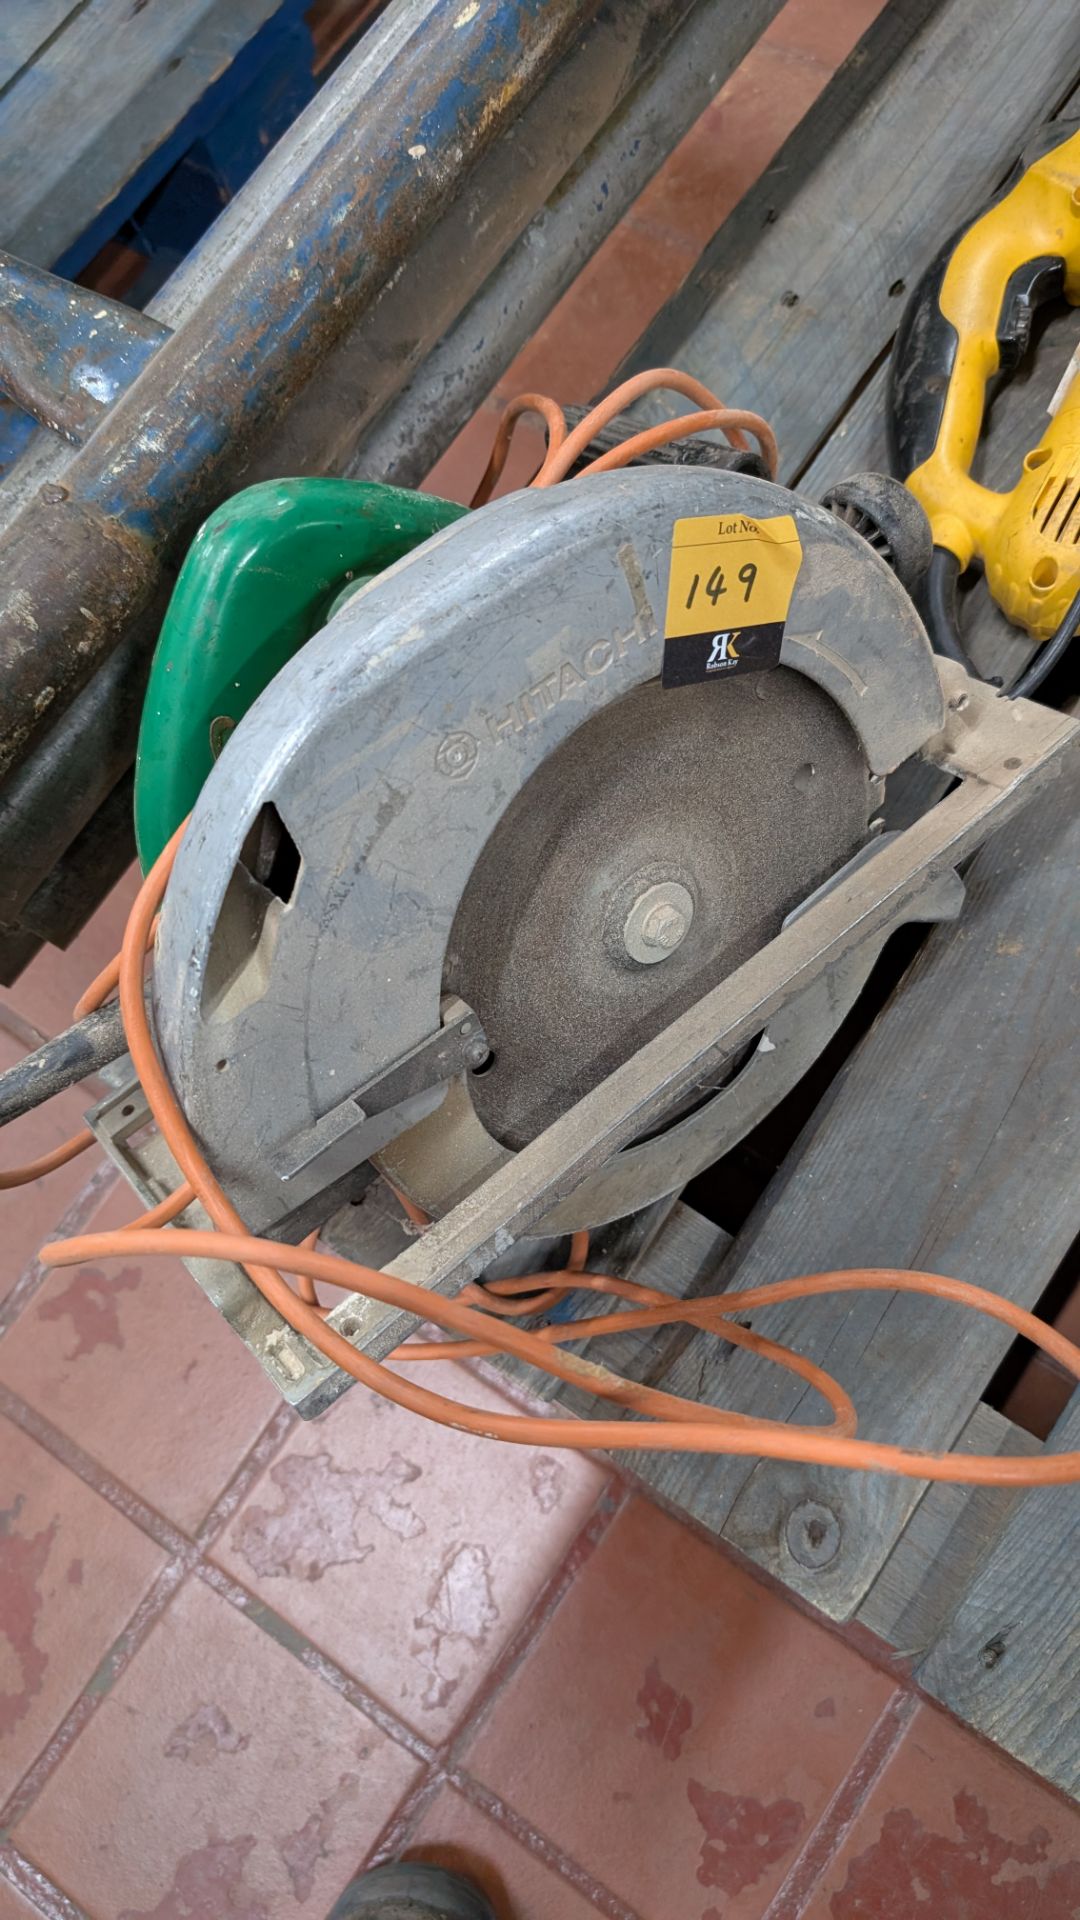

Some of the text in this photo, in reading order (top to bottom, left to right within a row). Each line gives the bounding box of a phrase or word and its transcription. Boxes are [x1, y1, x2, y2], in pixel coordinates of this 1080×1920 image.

[718, 522, 737, 535] Lot
[686, 563, 758, 609] 149
[482, 604, 658, 746] HITACHI
